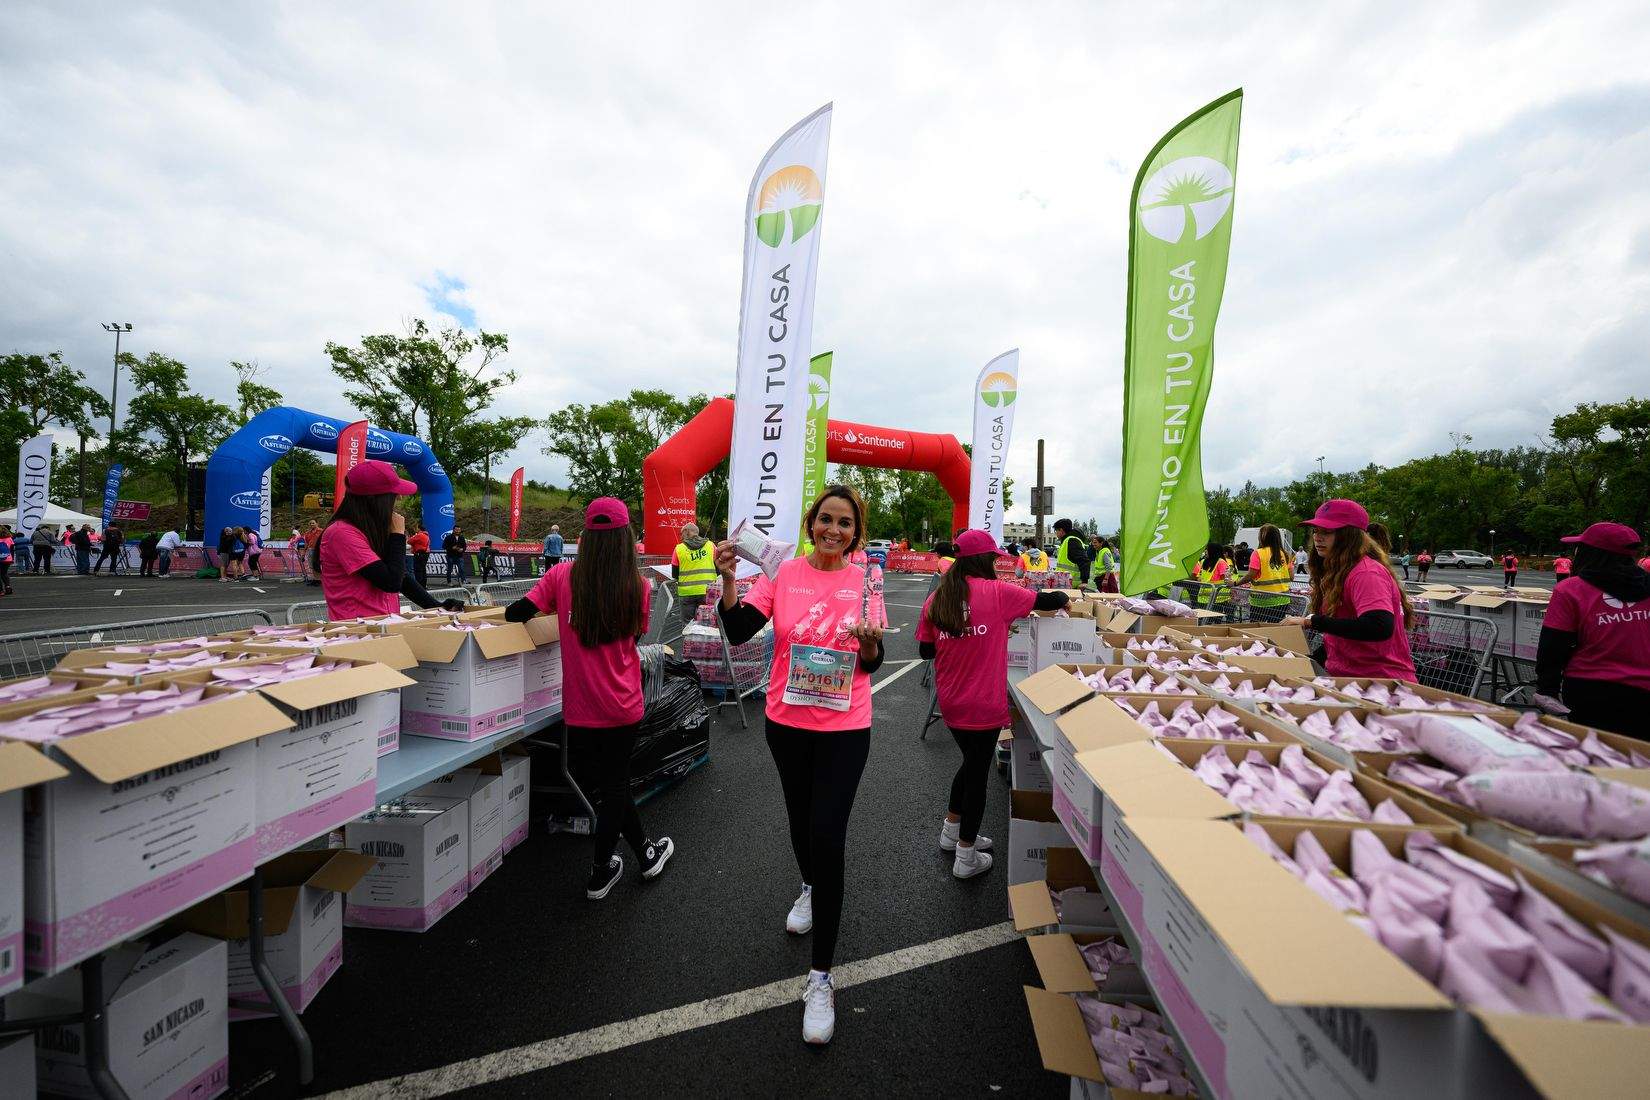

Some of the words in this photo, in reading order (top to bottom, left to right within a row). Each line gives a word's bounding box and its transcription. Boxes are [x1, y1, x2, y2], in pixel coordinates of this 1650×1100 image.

[768, 263, 791, 343] CASA
[1167, 260, 1197, 342] CASA
[765, 354, 787, 393] TU
[1165, 352, 1194, 393] TU
[763, 404, 785, 442] EN
[807, 417, 818, 455] CASA
[992, 415, 1005, 452] CASA
[1164, 404, 1190, 445] EN
[825, 430, 844, 441] orts
[858, 433, 906, 450] Santander
[806, 460, 816, 476] TU
[990, 455, 1002, 473] TU
[22, 454, 47, 531] OYSHO
[669, 496, 690, 505] Sports
[753, 451, 778, 536] MUTIO
[989, 477, 999, 495] EN
[984, 499, 996, 532] UTIO
[690, 548, 707, 562] Life
[1598, 610, 1650, 626] AMUTI
[1051, 641, 1062, 651] SAN
[1062, 641, 1083, 652] NICASIO
[361, 842, 375, 856] SAN
[376, 840, 405, 858] NICASIO
[435, 841, 444, 857] SAN
[1027, 848, 1038, 859] SAN
[143, 1025, 164, 1047] SAN
[166, 998, 205, 1034] NICASIO
